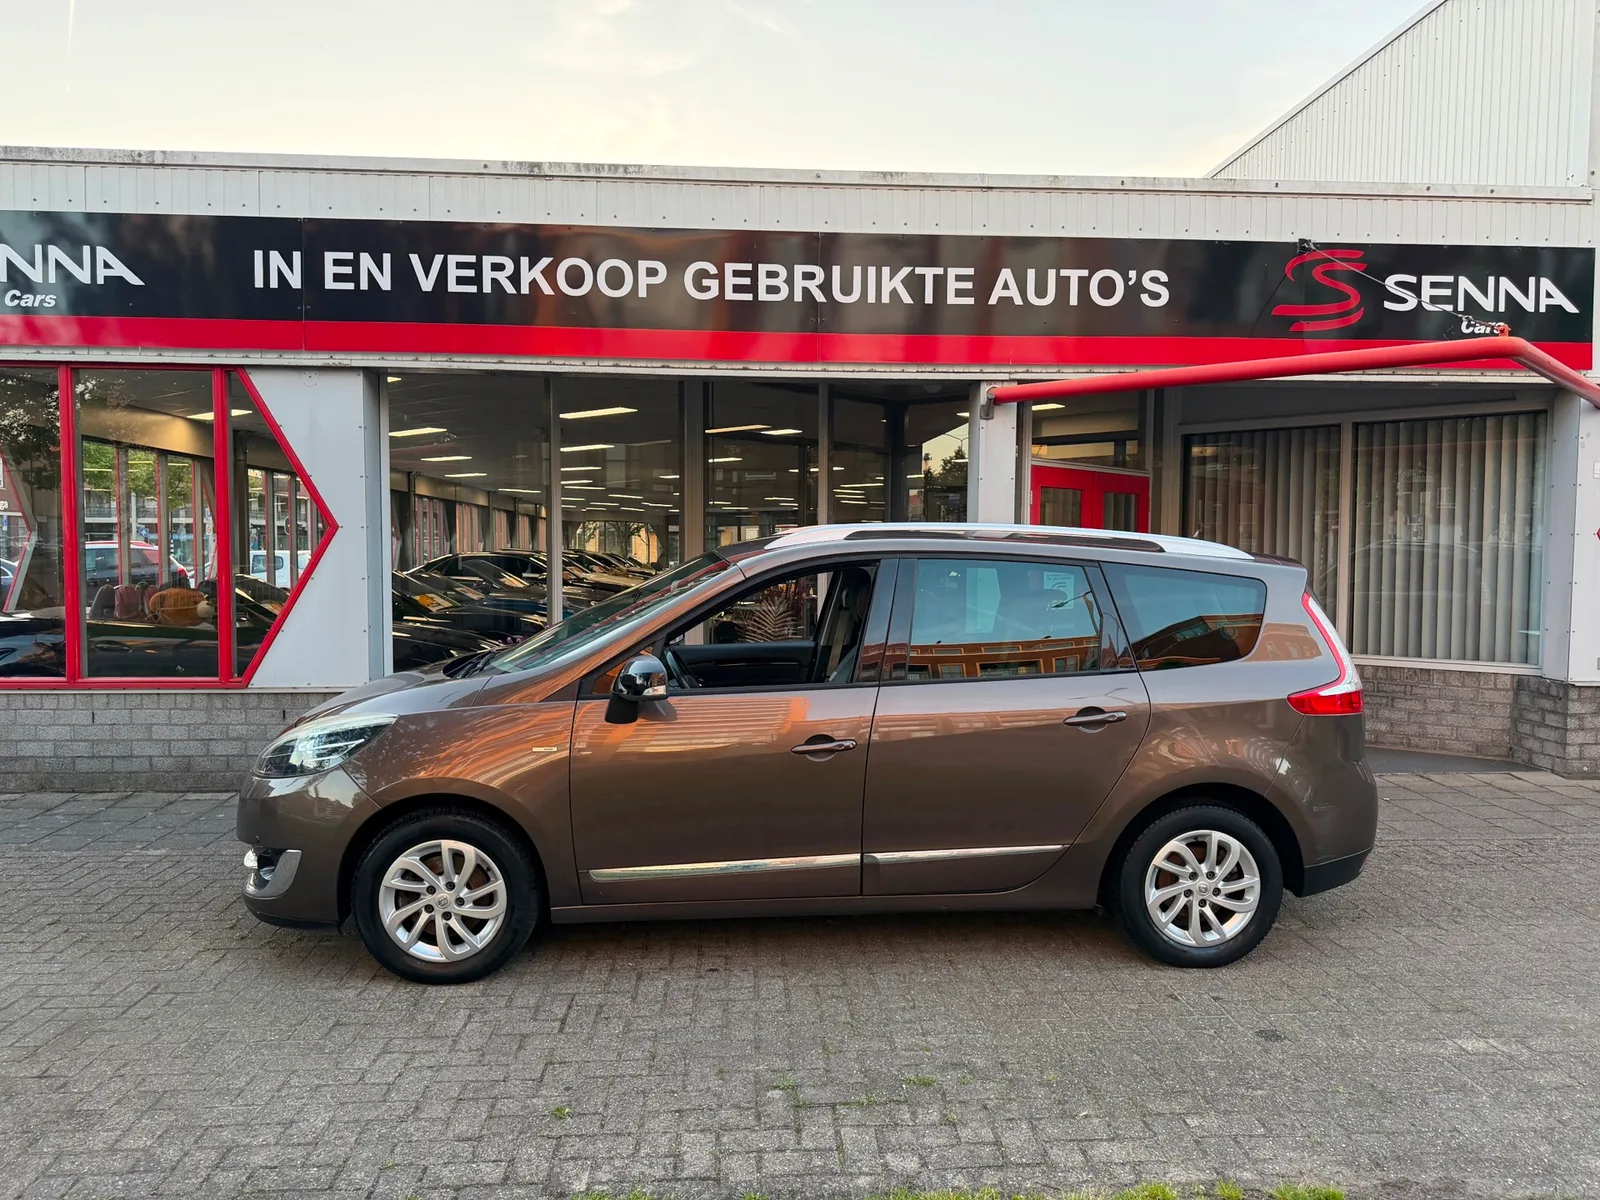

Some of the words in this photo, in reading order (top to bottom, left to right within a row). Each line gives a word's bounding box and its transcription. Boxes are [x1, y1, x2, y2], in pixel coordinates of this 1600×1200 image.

[0, 244, 145, 286] NNA
[254, 250, 301, 288] IN
[324, 251, 391, 290] EN
[409, 253, 667, 298] VERKOOP
[684, 261, 975, 305] GEBRUIKTE
[4, 289, 57, 308] Cars
[1383, 274, 1580, 314] SENNA
